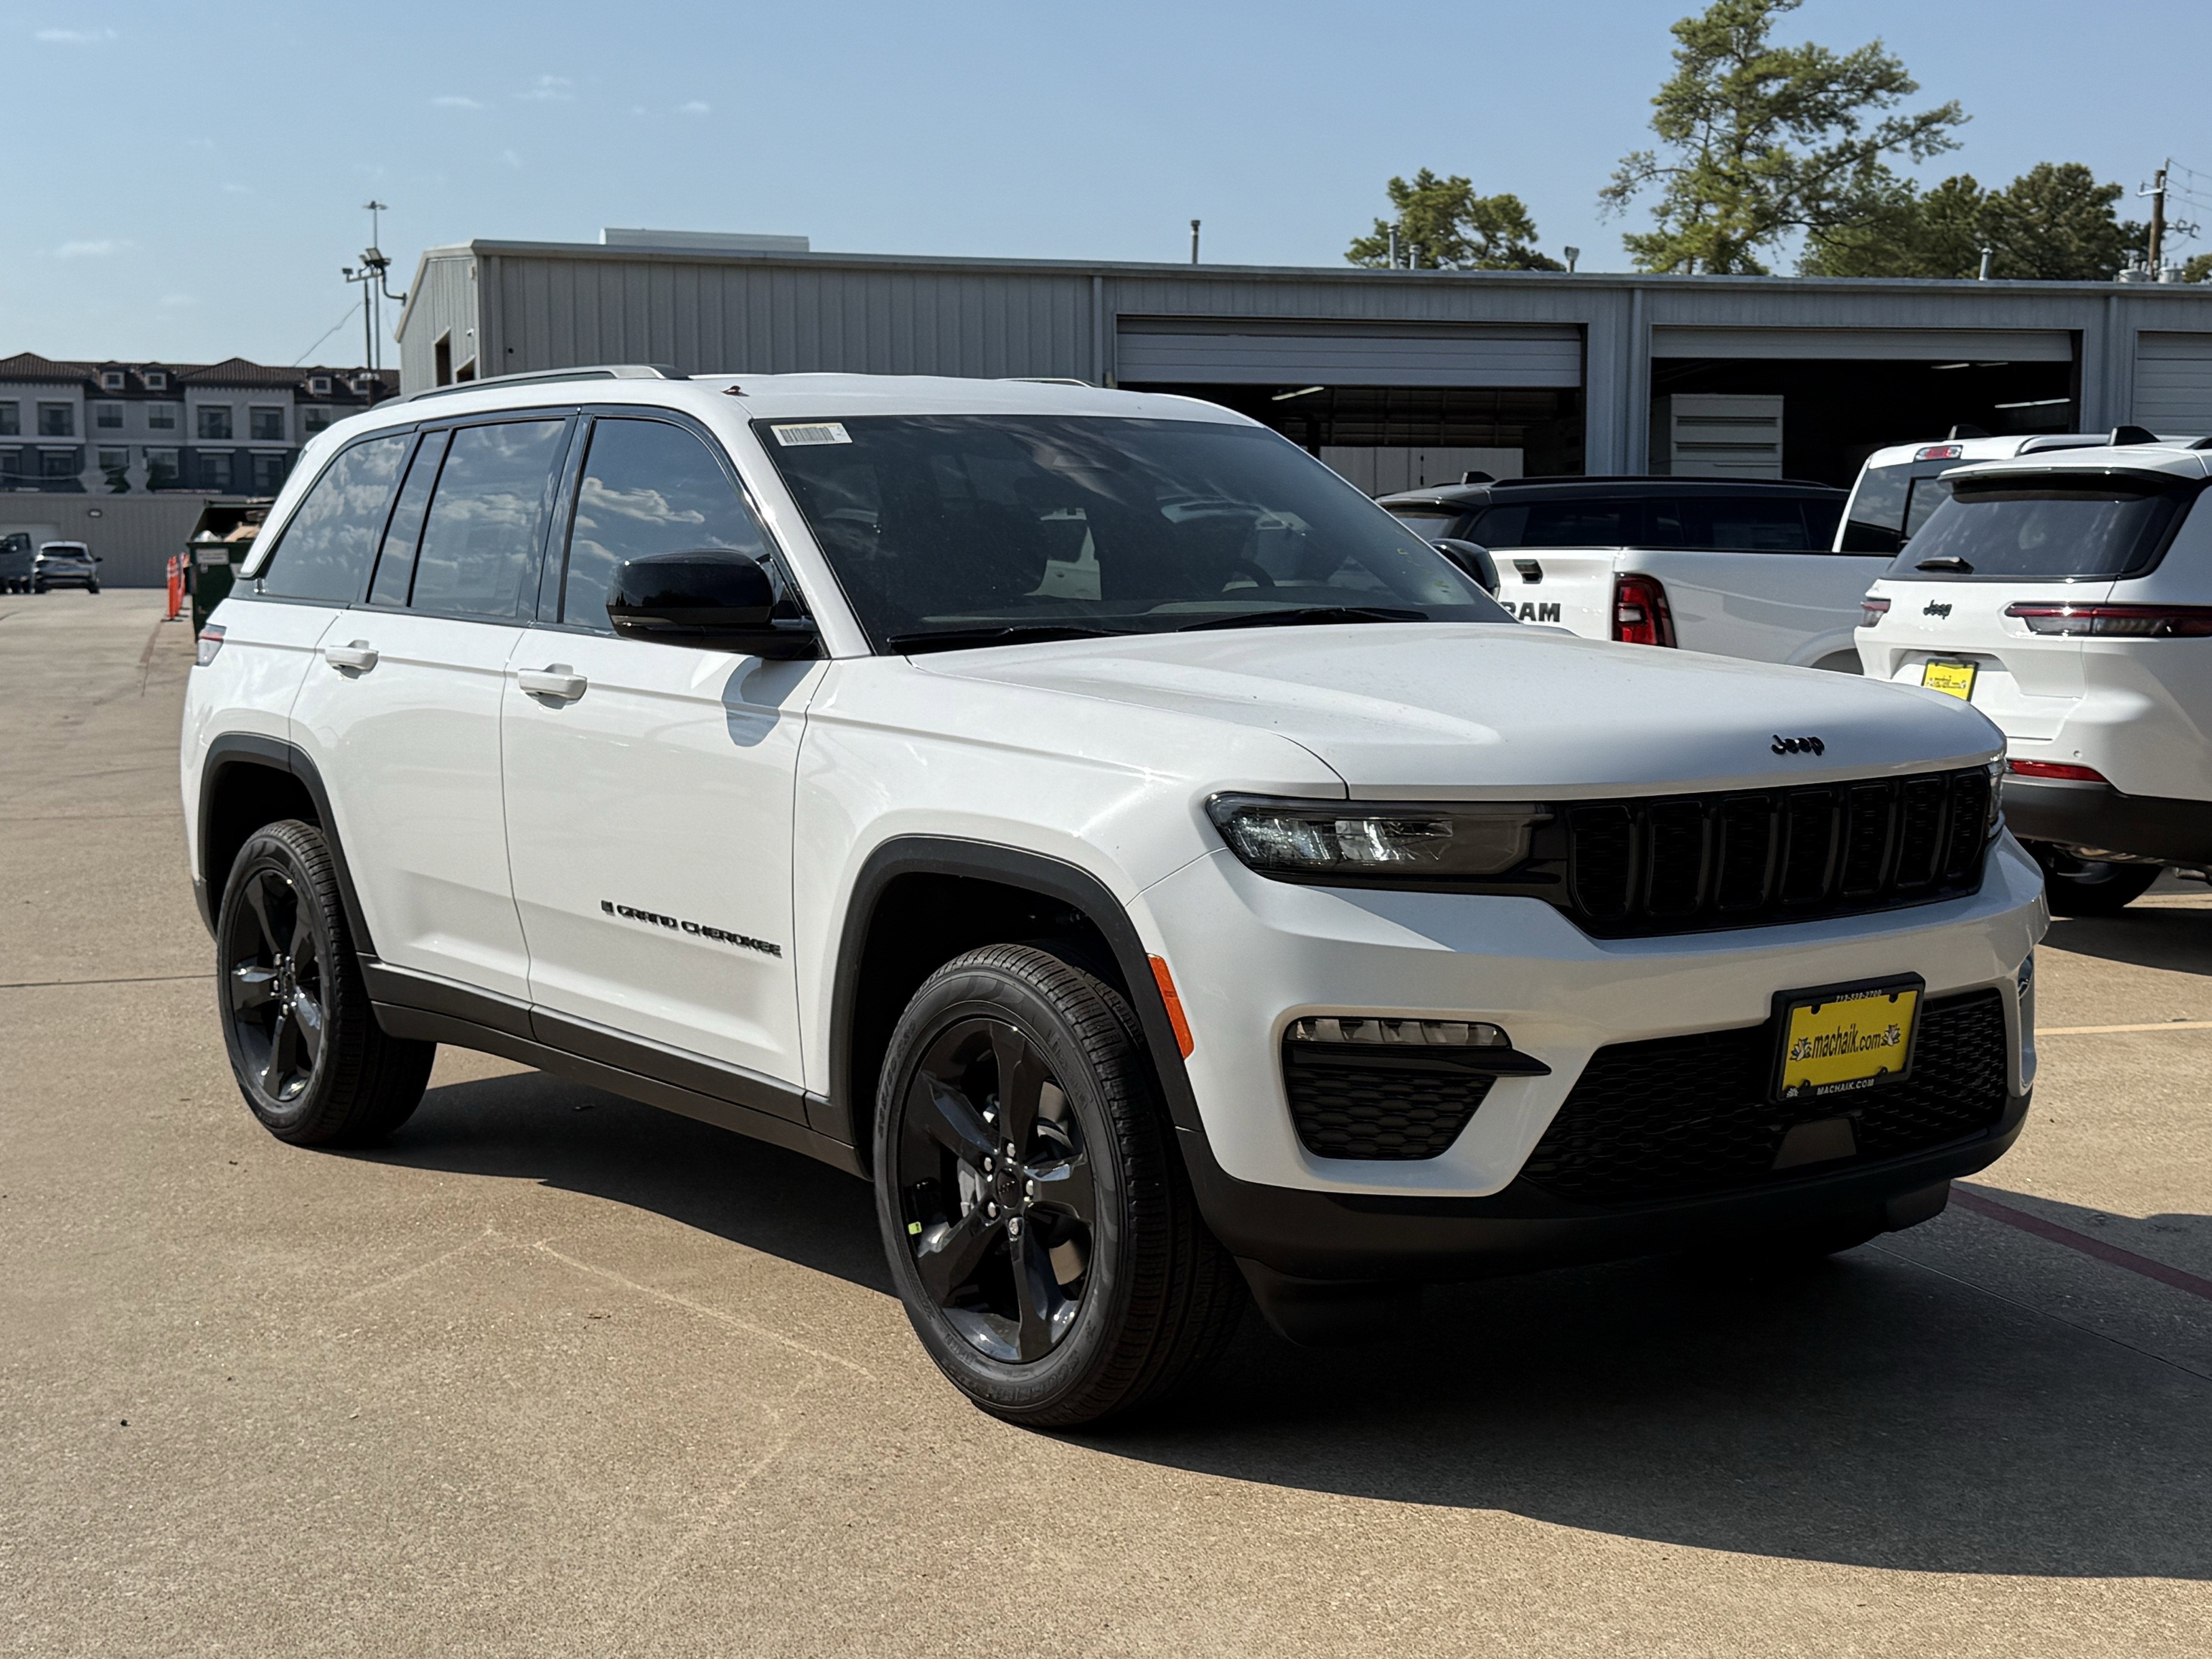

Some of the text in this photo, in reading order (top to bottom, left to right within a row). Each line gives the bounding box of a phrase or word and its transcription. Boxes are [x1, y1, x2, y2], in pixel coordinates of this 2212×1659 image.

[1771, 734, 1825, 756] Jeep
[681, 921, 782, 958] CHEROKEE
[1811, 1023, 1881, 1059] machaik.com
[1817, 1079, 1875, 1095] MACHAIK.COM
